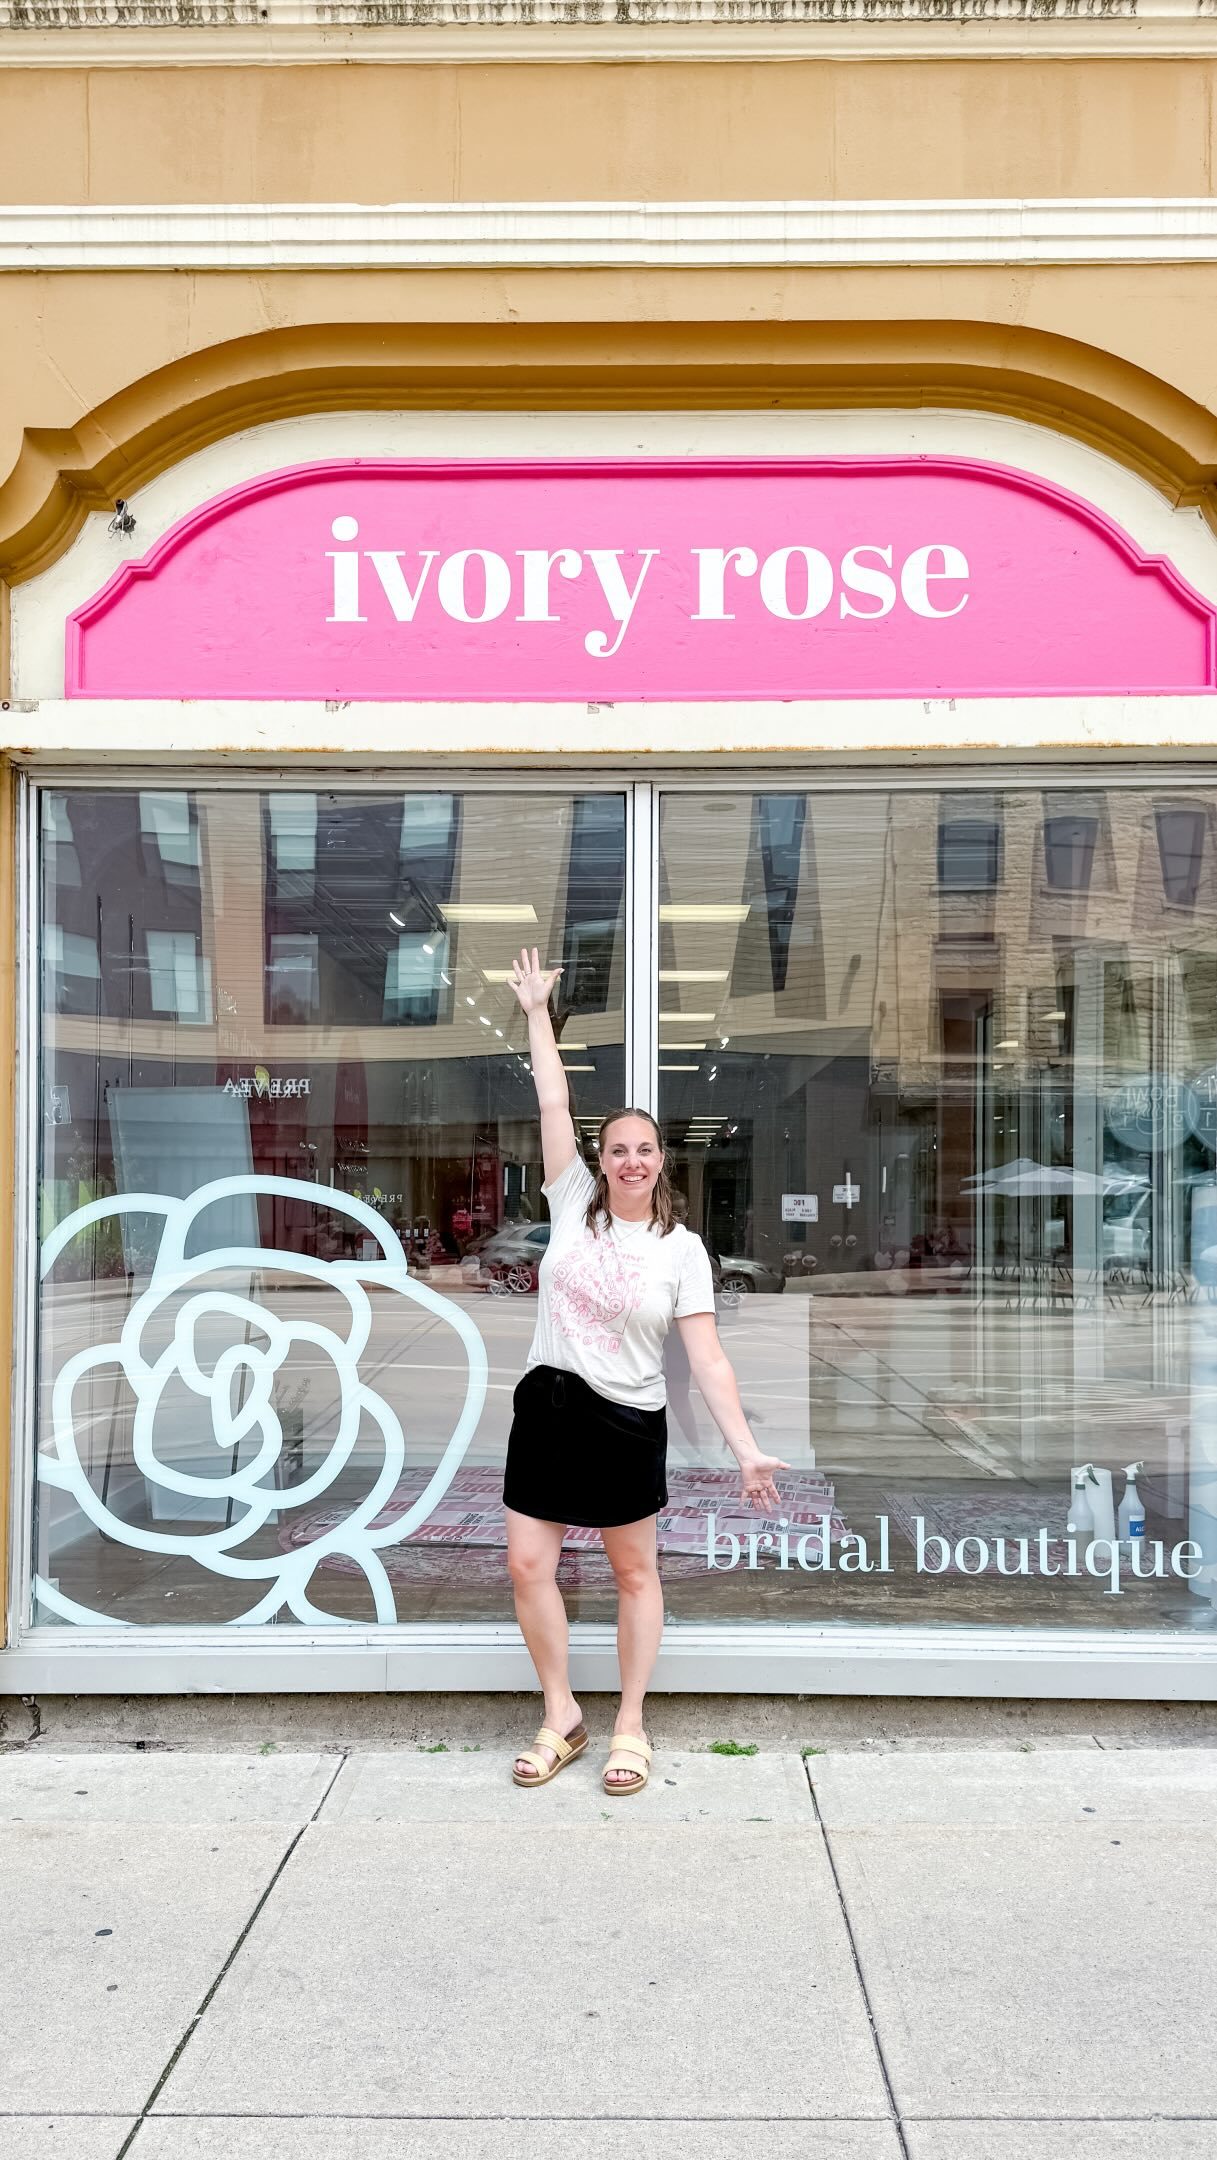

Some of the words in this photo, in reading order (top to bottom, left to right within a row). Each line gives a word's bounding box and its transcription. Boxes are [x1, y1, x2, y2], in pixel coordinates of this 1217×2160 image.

[325, 516, 660, 658] ivory
[691, 545, 969, 620] rose
[703, 1513, 895, 1572] bridal
[910, 1516, 1203, 1594] boutique
